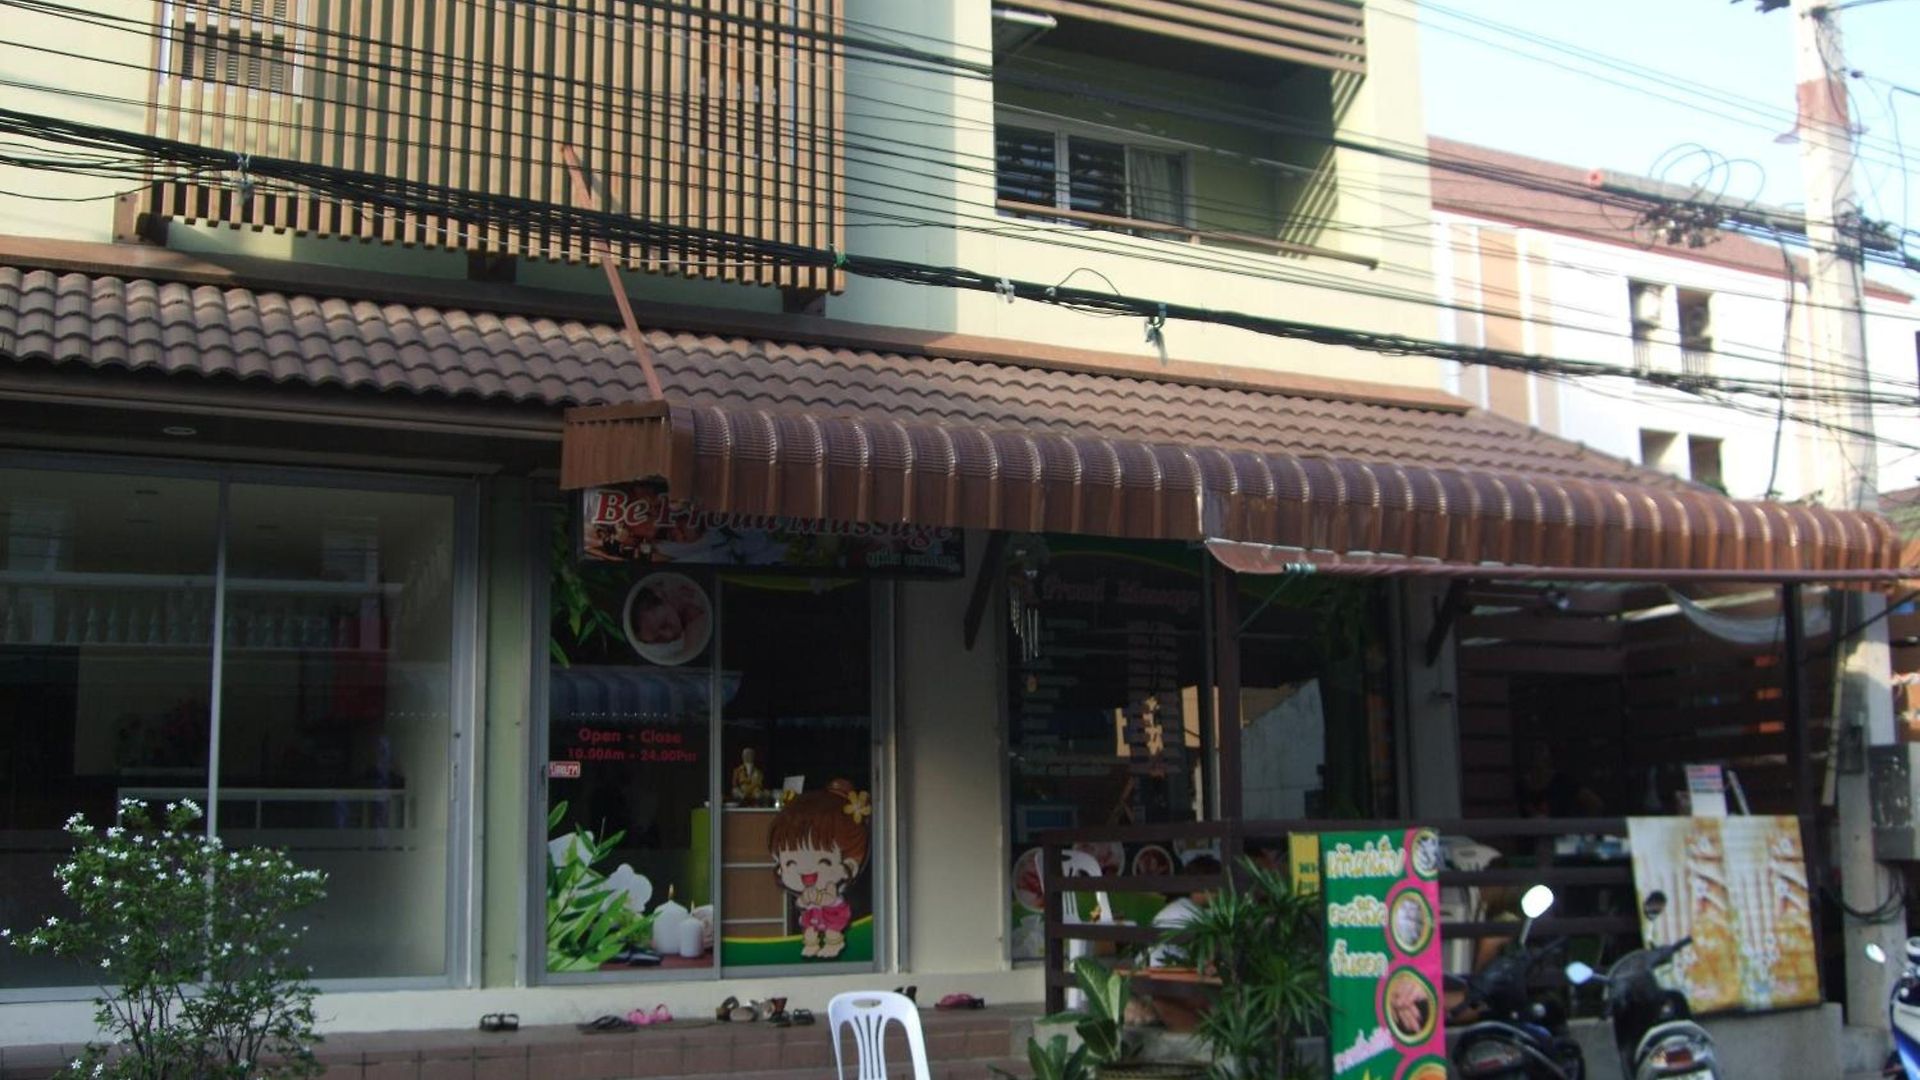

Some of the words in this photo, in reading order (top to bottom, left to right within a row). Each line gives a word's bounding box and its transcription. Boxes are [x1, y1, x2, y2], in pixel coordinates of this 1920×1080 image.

[591, 489, 650, 526] Be
[578, 727, 621, 743] Open
[640, 729, 683, 744] Close
